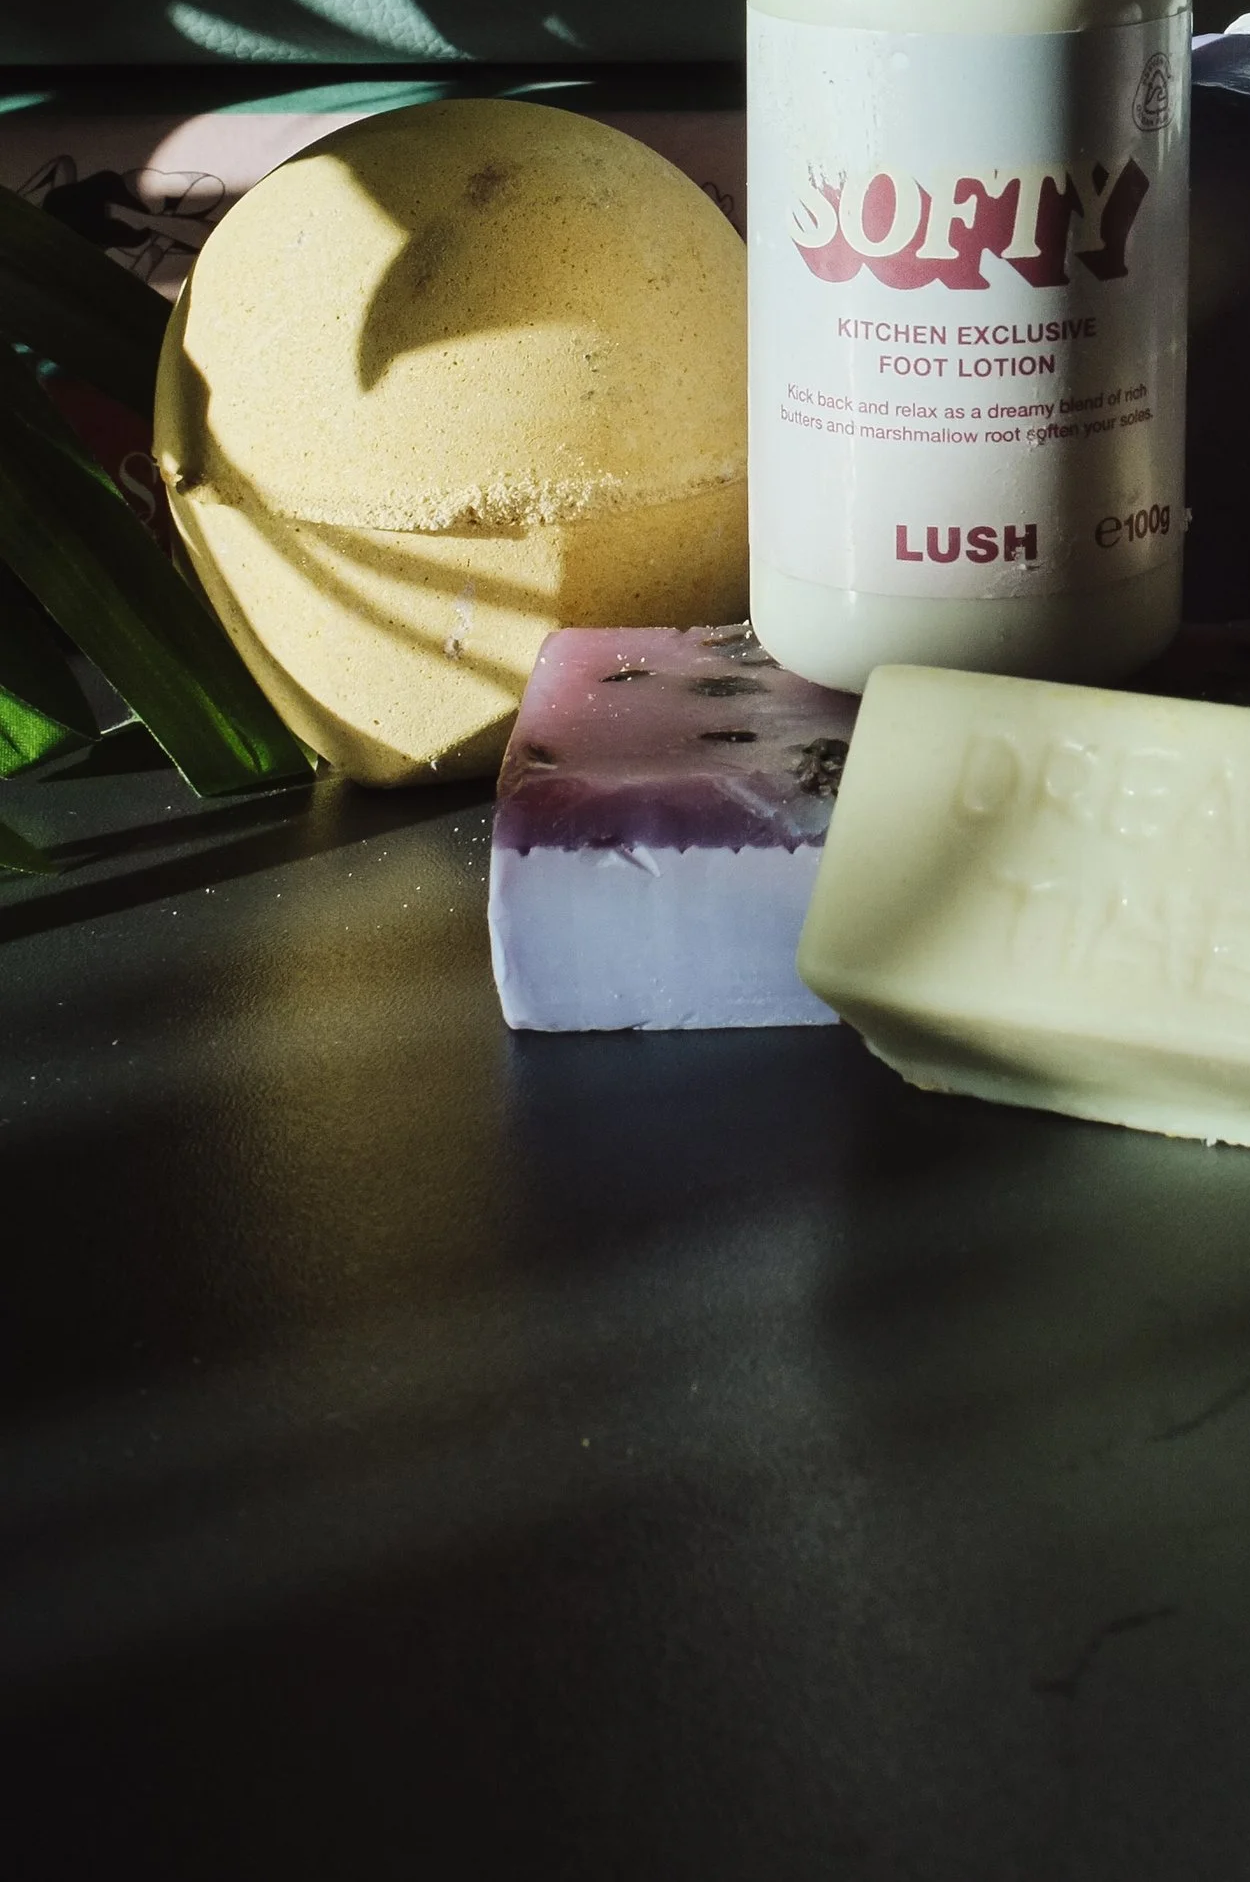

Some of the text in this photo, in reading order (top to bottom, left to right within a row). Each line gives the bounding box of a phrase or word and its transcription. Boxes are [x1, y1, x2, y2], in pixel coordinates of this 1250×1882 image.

[791, 158, 1151, 290] SOFTY
[837, 317, 1097, 345] KITCHEN EXCLUSIVE
[879, 355, 1056, 378] FOOT LOTION
[787, 382, 1148, 419] Kick back and relax as a dreamy blend of rich
[780, 404, 1154, 445] butters and marshmallow root soften your soles.
[895, 523, 1038, 563] LUSH
